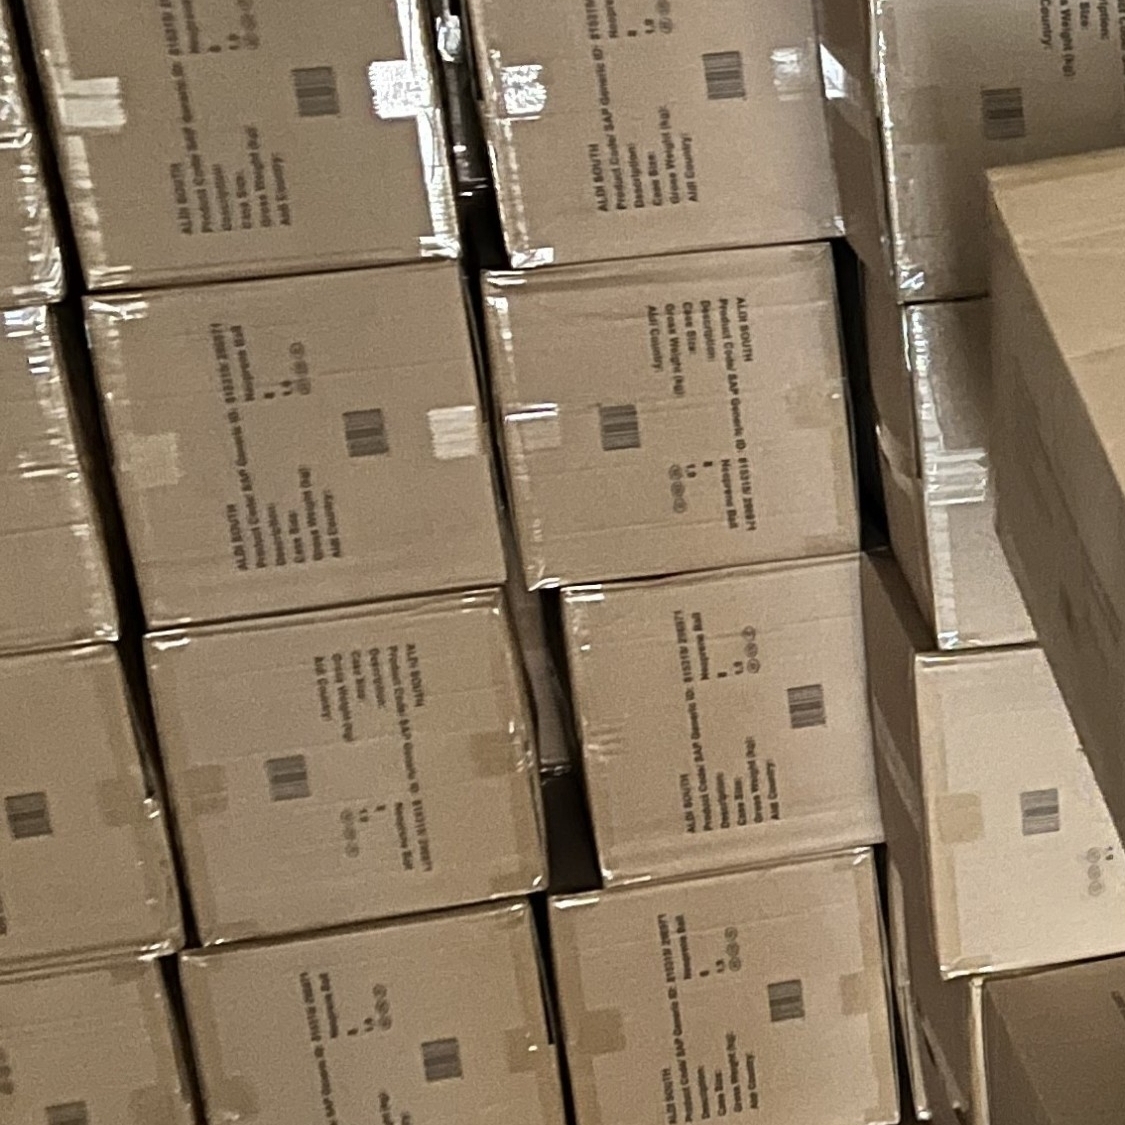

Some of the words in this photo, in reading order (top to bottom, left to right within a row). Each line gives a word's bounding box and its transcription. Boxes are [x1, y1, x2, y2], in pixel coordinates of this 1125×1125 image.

[1060, 8, 1073, 50] Weight
[596, 62, 610, 105] Generic
[601, 108, 614, 130] SAP
[588, 143, 603, 182] SOUTH
[594, 185, 608, 211] ALDI
[610, 167, 626, 209] Product
[646, 305, 658, 325] Aldi
[718, 298, 732, 339] Product
[736, 297, 748, 321] ALDI
[739, 324, 753, 361] SOUTH
[727, 373, 739, 395] SAP
[730, 397, 742, 436] Generic
